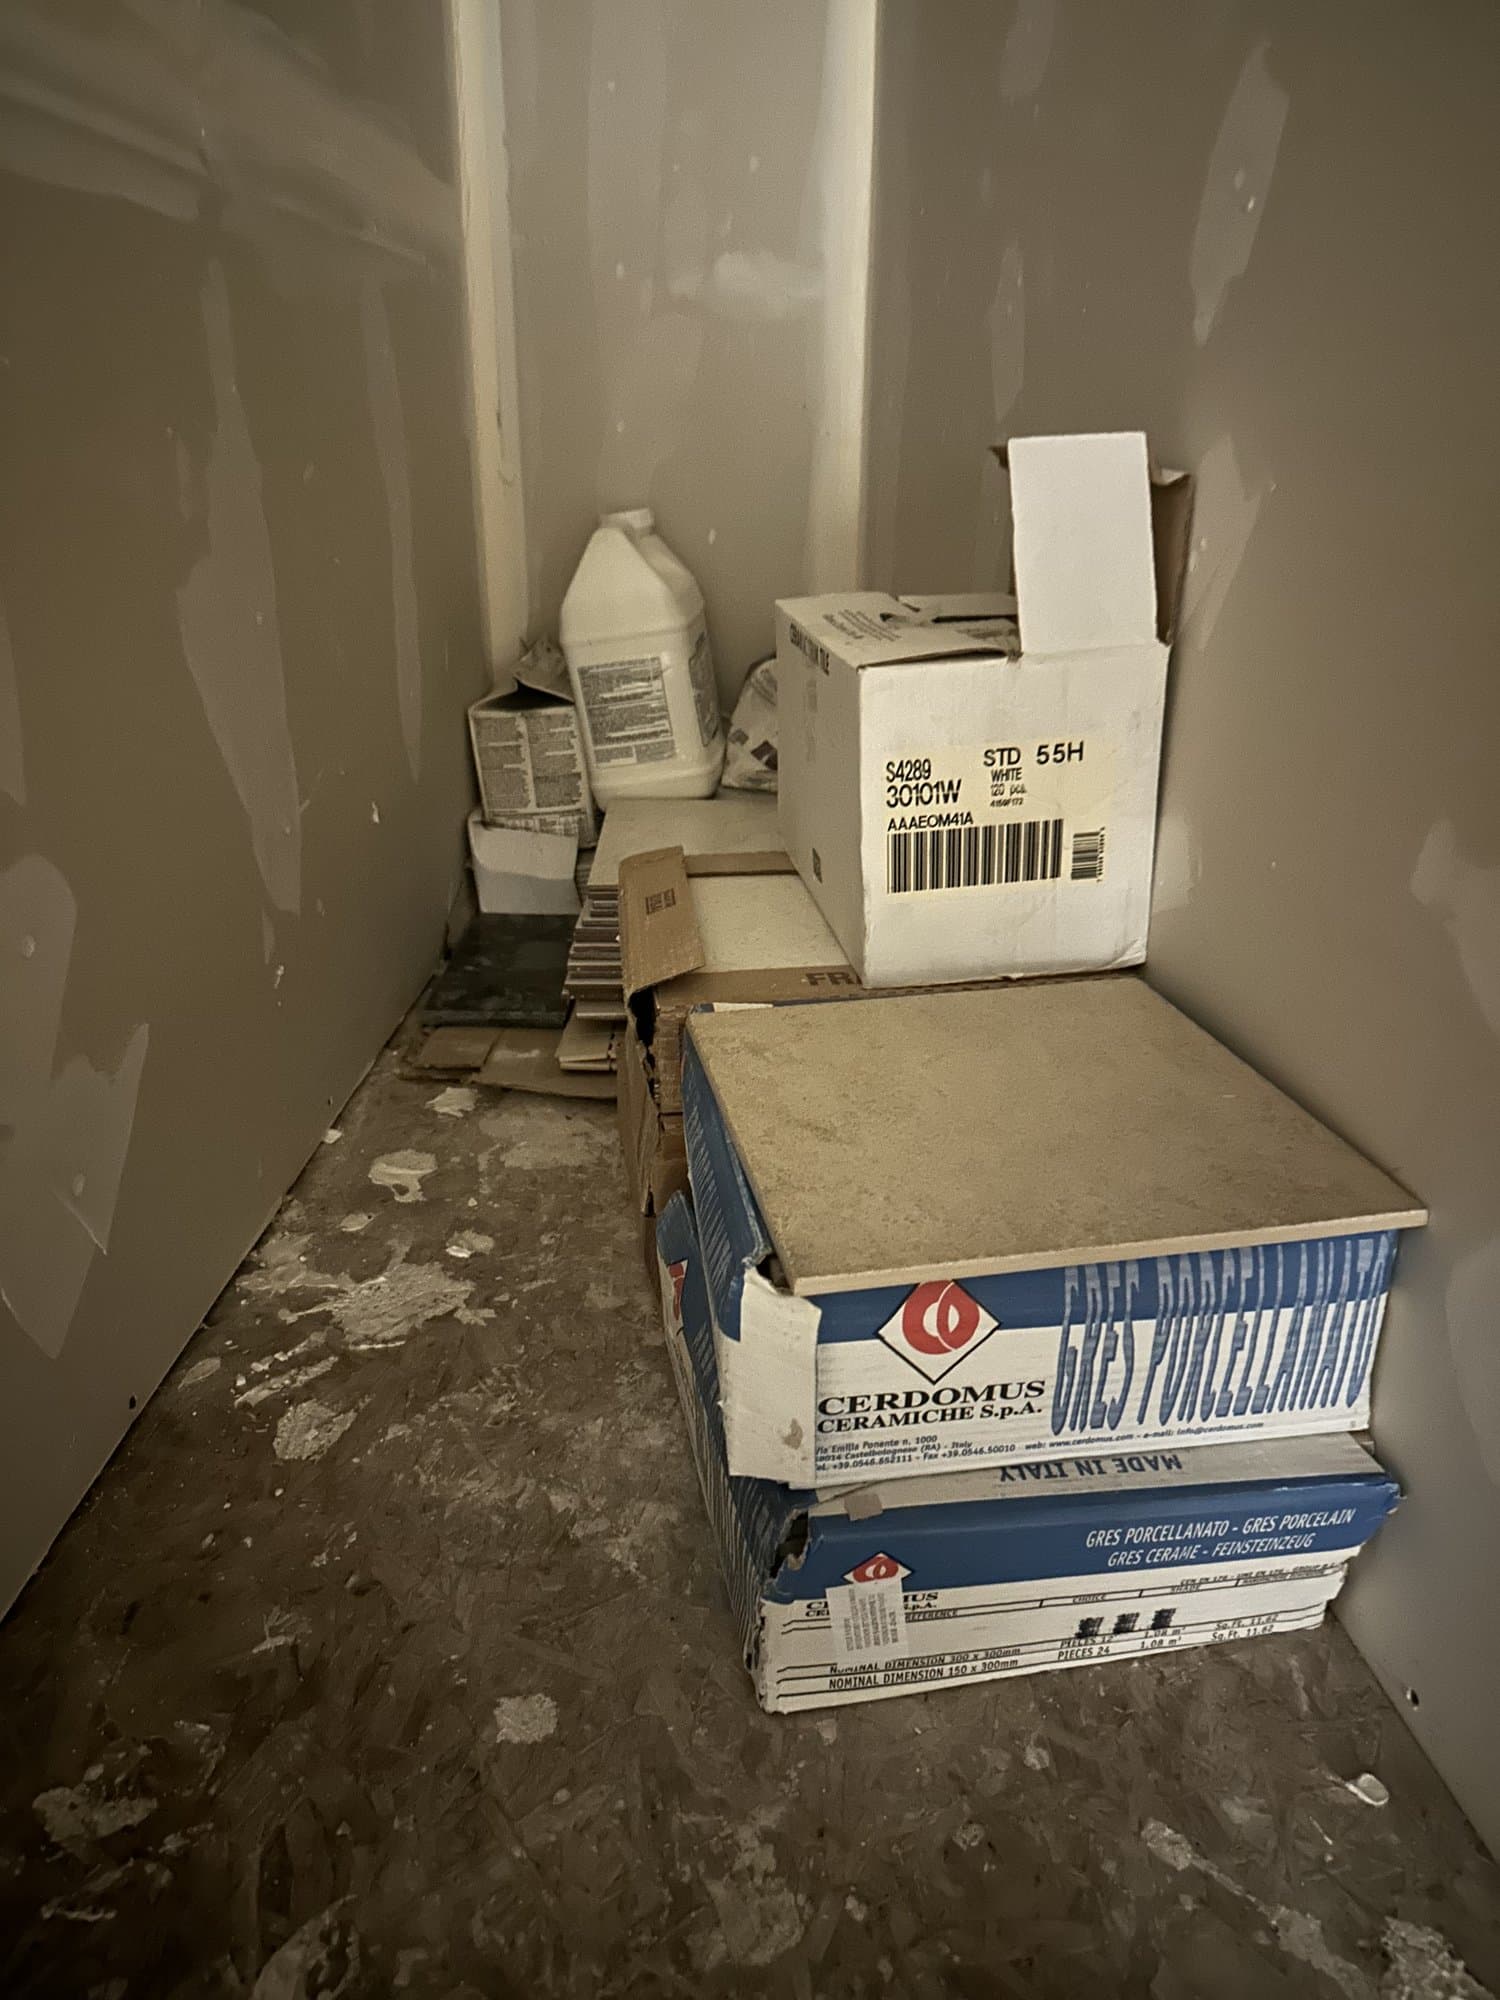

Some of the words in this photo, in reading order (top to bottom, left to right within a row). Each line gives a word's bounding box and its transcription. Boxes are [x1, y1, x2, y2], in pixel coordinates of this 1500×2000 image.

[983, 747, 1021, 767] STD
[1036, 741, 1084, 765] 55H
[886, 758, 931, 783] S4289
[990, 767, 1022, 783] WHITE
[886, 779, 961, 808] 30101W
[817, 1380, 1046, 1416] CERDOMUS
[817, 1406, 974, 1434] CERAMICHE
[979, 1401, 1043, 1420] S.p.A.
[863, 1440, 899, 1450] Ponente
[915, 1435, 938, 1445] 1000
[999, 1462, 1070, 1483] ITALY
[1074, 1459, 1108, 1477] IN
[1115, 1454, 1183, 1475] MADE
[1086, 1529, 1122, 1548] GRES
[1124, 1520, 1230, 1545] PORCELLANATO
[1242, 1515, 1279, 1535] GRES
[1279, 1508, 1356, 1531] PORCELAIN
[1108, 1550, 1141, 1567] GRES
[1146, 1544, 1201, 1563] CERAME
[1212, 1533, 1316, 1557] FEINSTEINZEUG
[885, 1657, 945, 1670] DIMENSION
[951, 1654, 969, 1664] 300
[1057, 1647, 1093, 1660] PIECES
[828, 1674, 879, 1689] NOMINAL
[883, 1668, 944, 1684] DIMENSION
[949, 1666, 967, 1676] 150
[981, 1658, 1019, 1671] 300mm
